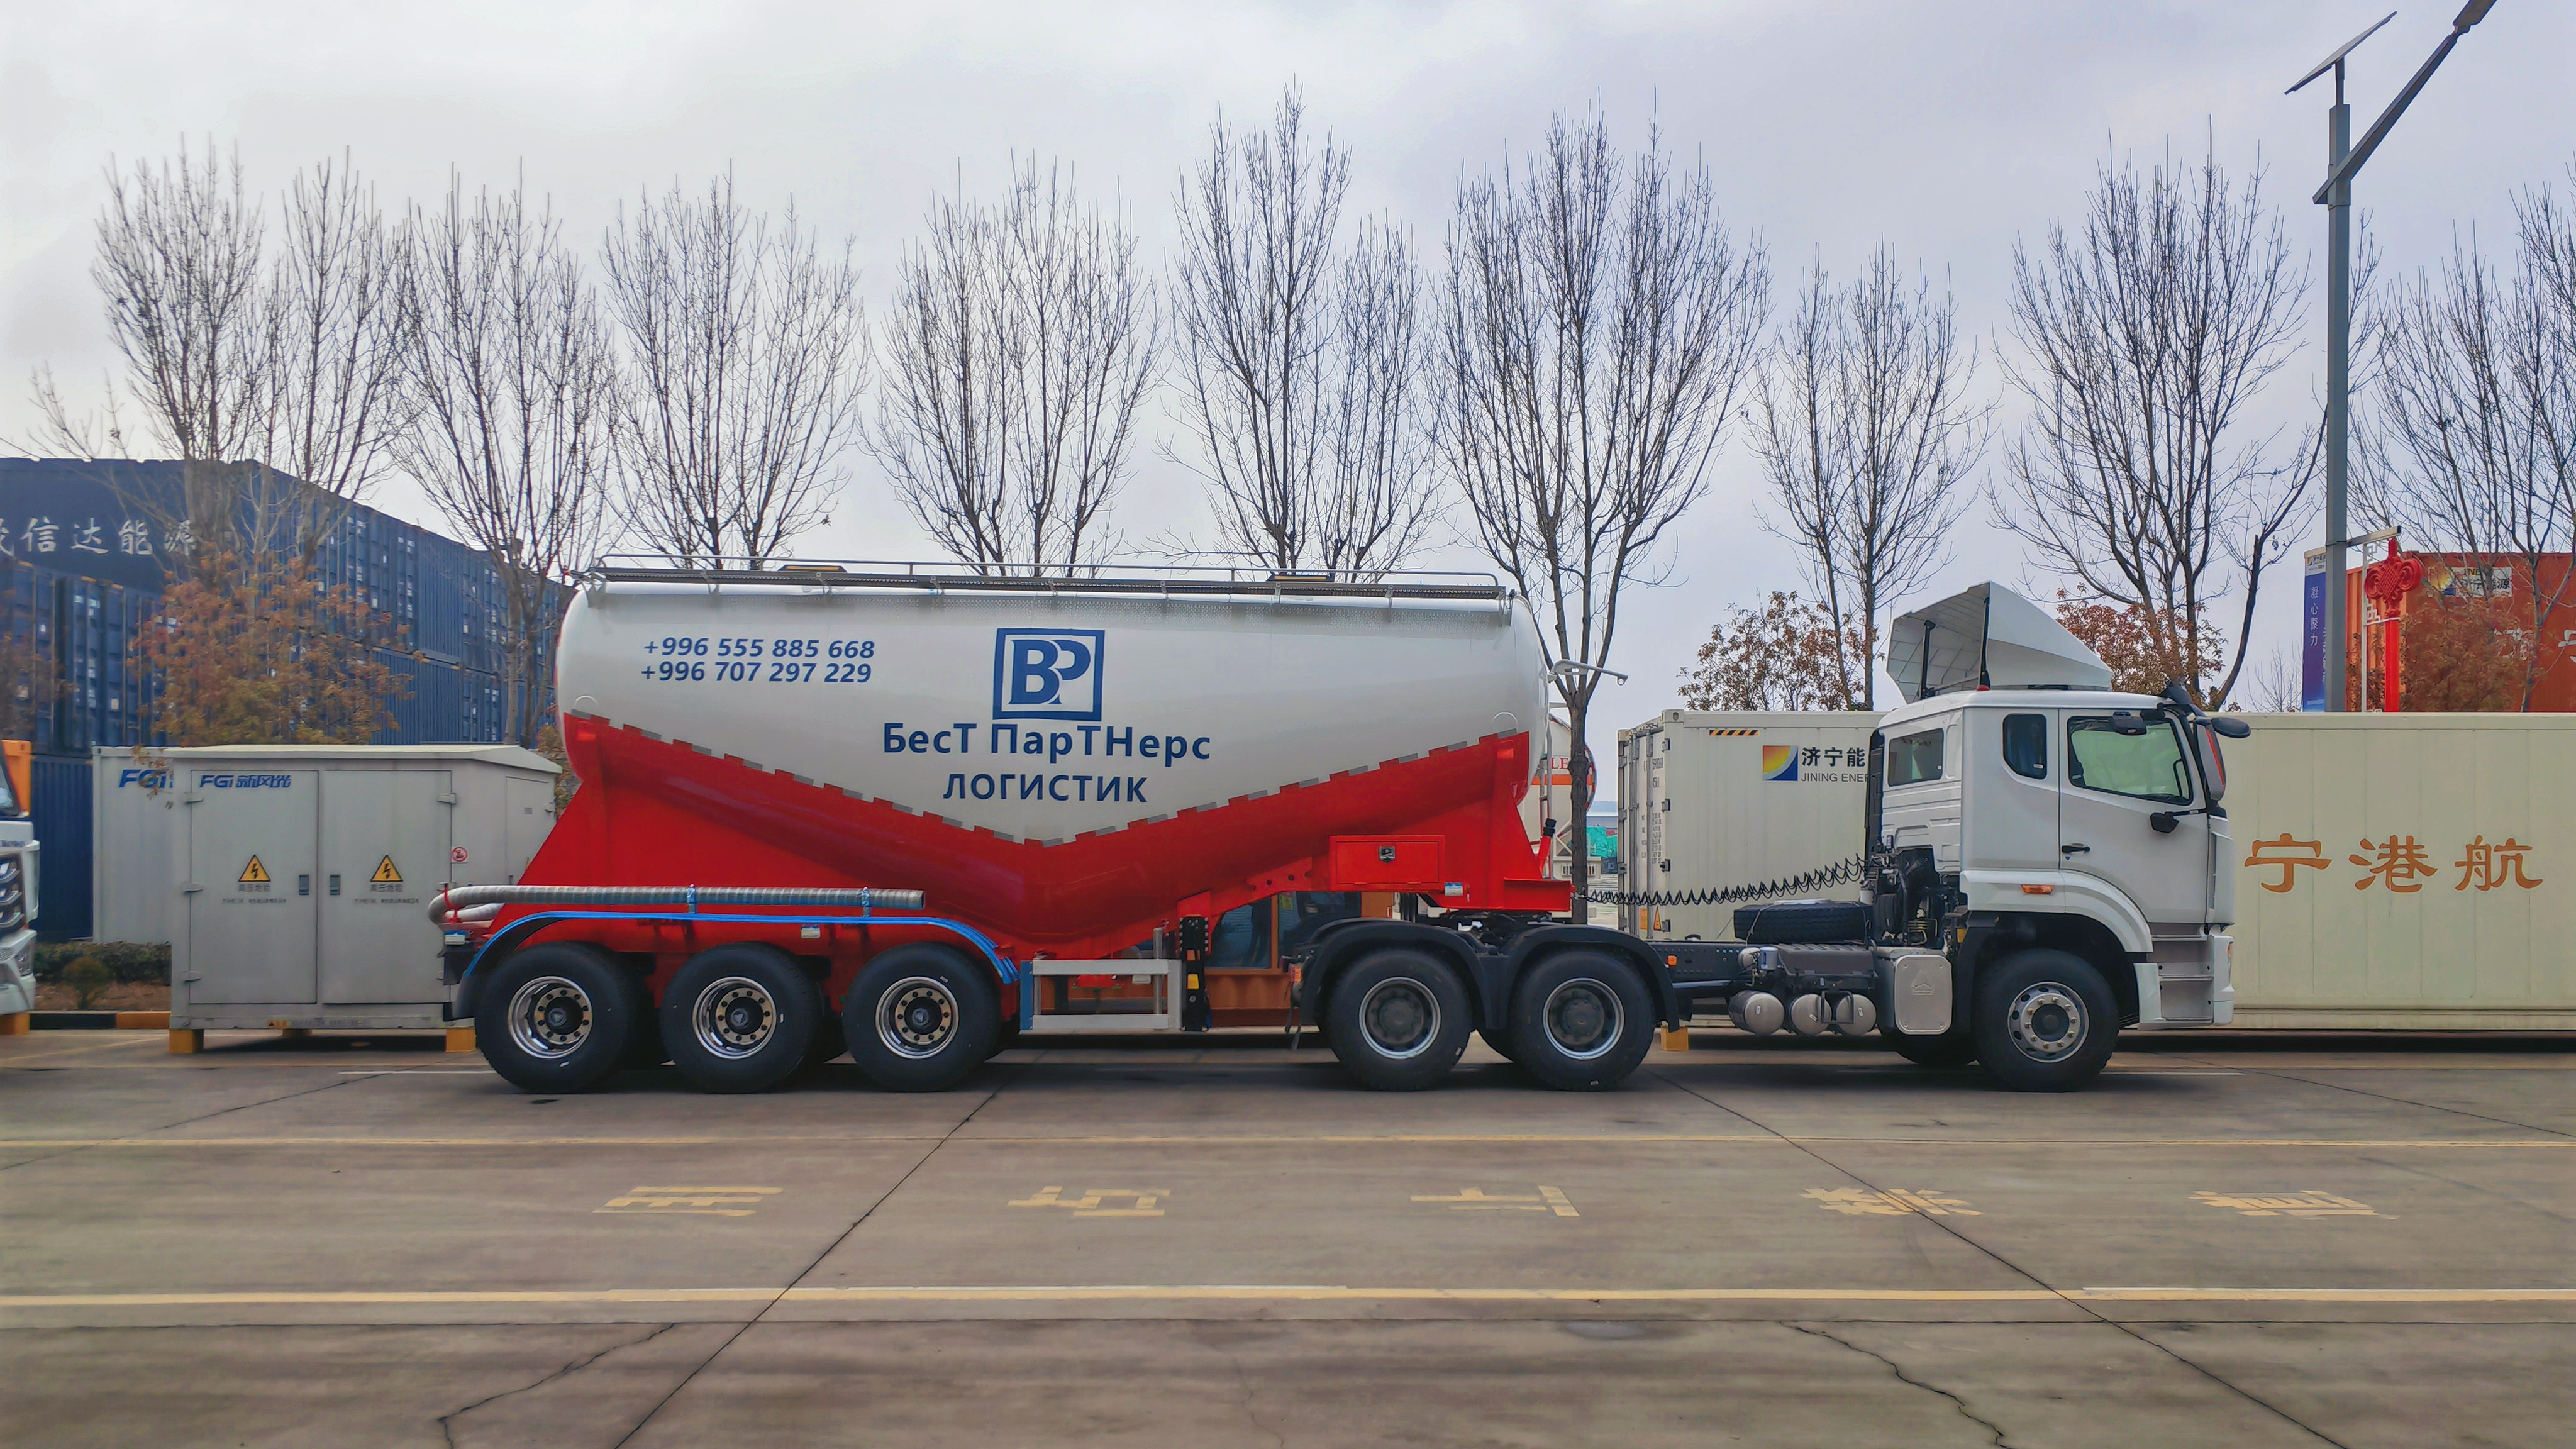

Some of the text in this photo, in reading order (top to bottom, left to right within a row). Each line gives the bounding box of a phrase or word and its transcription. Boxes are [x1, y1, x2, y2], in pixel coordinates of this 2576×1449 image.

[2310, 586, 2319, 647] 凝心聚力
[644, 636, 875, 660] +996 555 885 668
[641, 661, 872, 684] +996 707 297 229
[1008, 639, 1091, 705] BP
[1801, 747, 1865, 767] 济宁能
[199, 775, 234, 788] FGI
[1801, 773, 1838, 783] JINING
[2244, 833, 2544, 894] 宁港航
